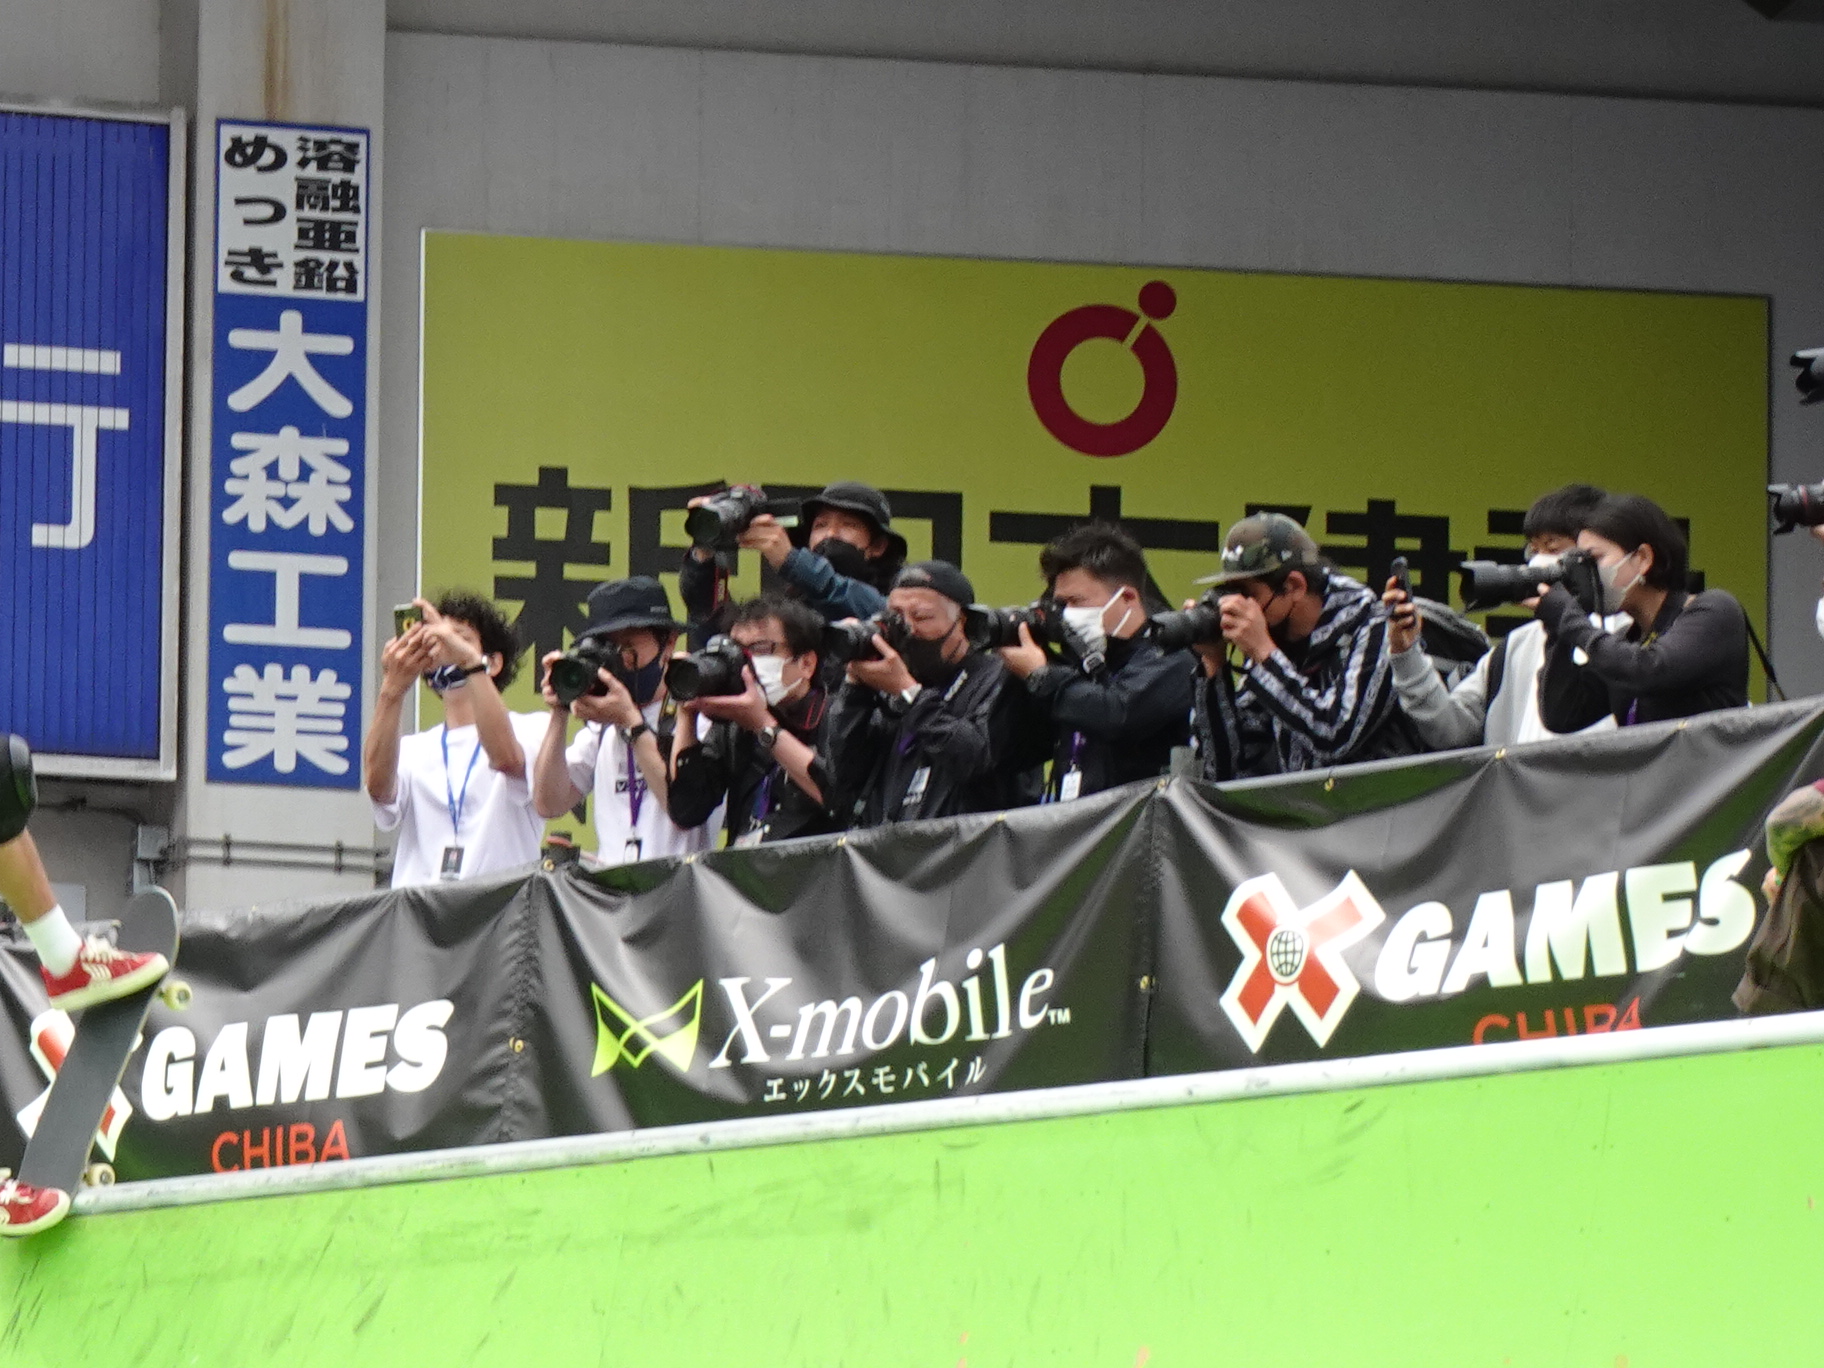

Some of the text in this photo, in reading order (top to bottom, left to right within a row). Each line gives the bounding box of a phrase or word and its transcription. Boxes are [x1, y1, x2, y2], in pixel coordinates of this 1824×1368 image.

[222, 310, 354, 775] 大森工業
[1375, 849, 1756, 1001] GAMES
[141, 1000, 454, 1121] GAMES
[763, 1056, 987, 1102] エックスモバイル
[211, 1119, 351, 1174] CHIBA
